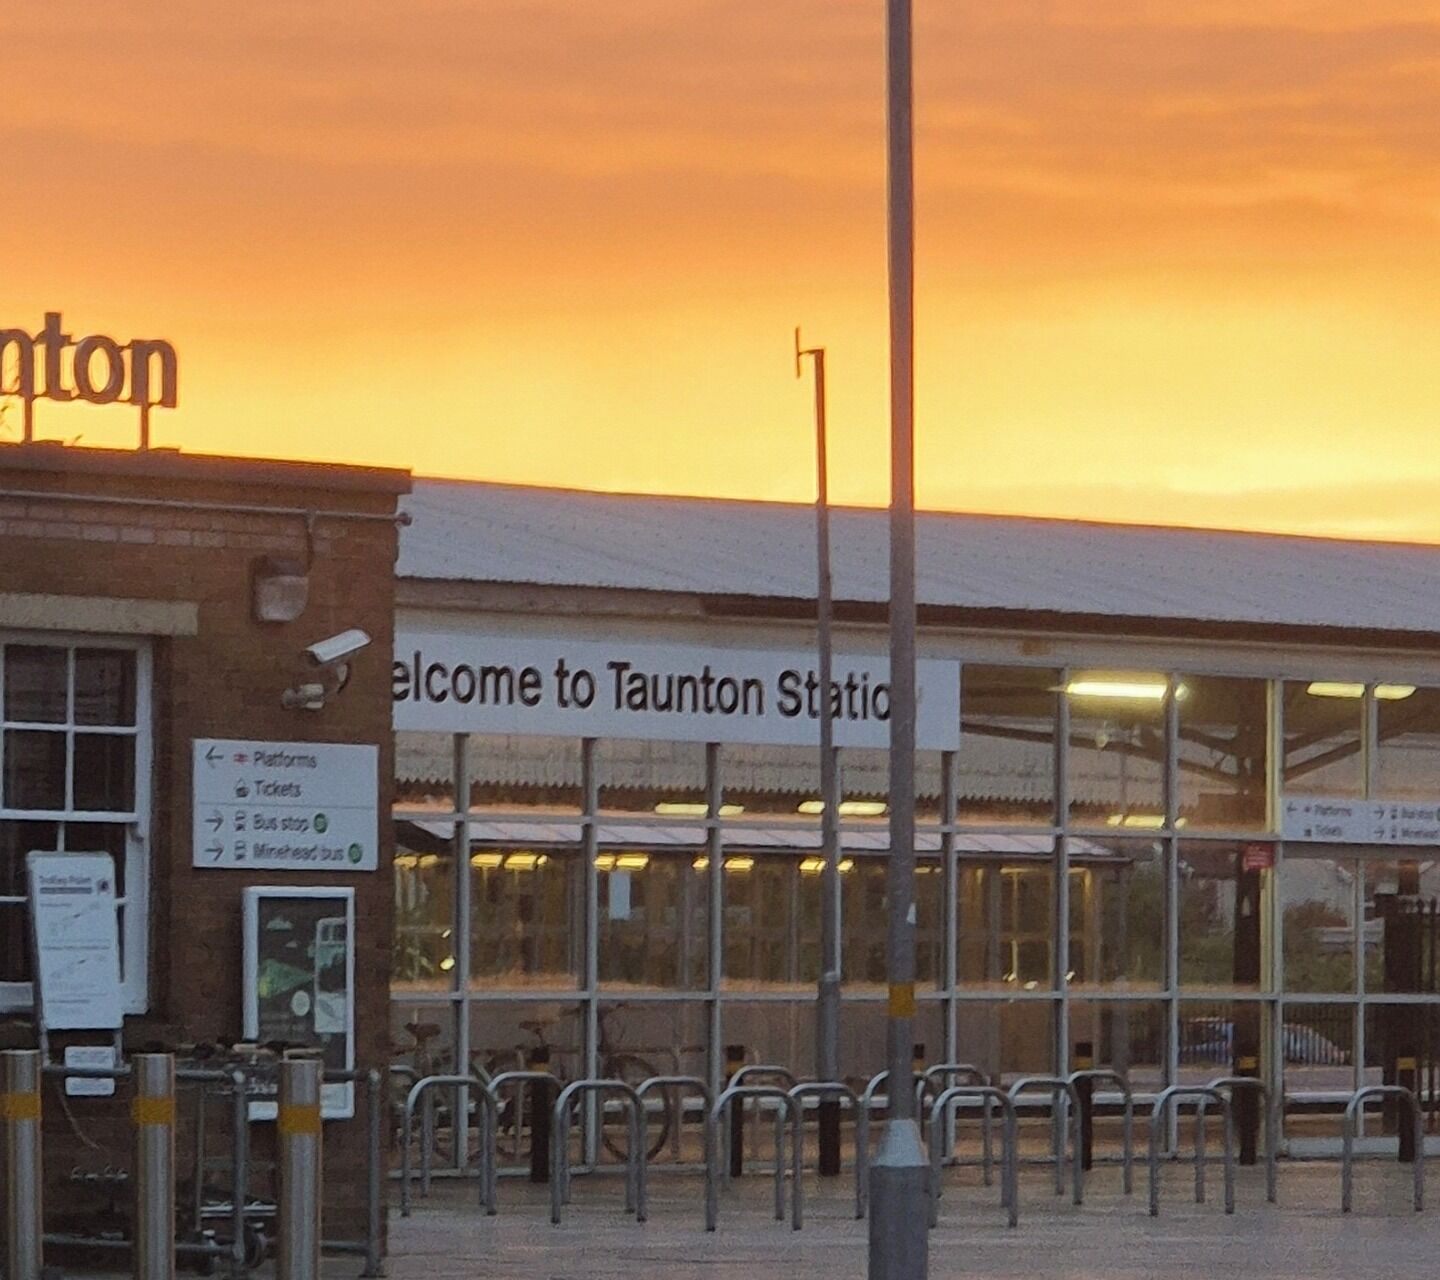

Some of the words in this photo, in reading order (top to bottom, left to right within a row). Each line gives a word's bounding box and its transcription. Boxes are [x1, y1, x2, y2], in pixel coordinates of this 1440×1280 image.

[391, 649, 542, 707] elcome
[554, 657, 596, 709] to
[607, 660, 765, 716] Taunton
[777, 669, 894, 722] Statio
[254, 751, 317, 769] Platforms
[254, 780, 301, 798] Tickets
[253, 813, 278, 831] Bus
